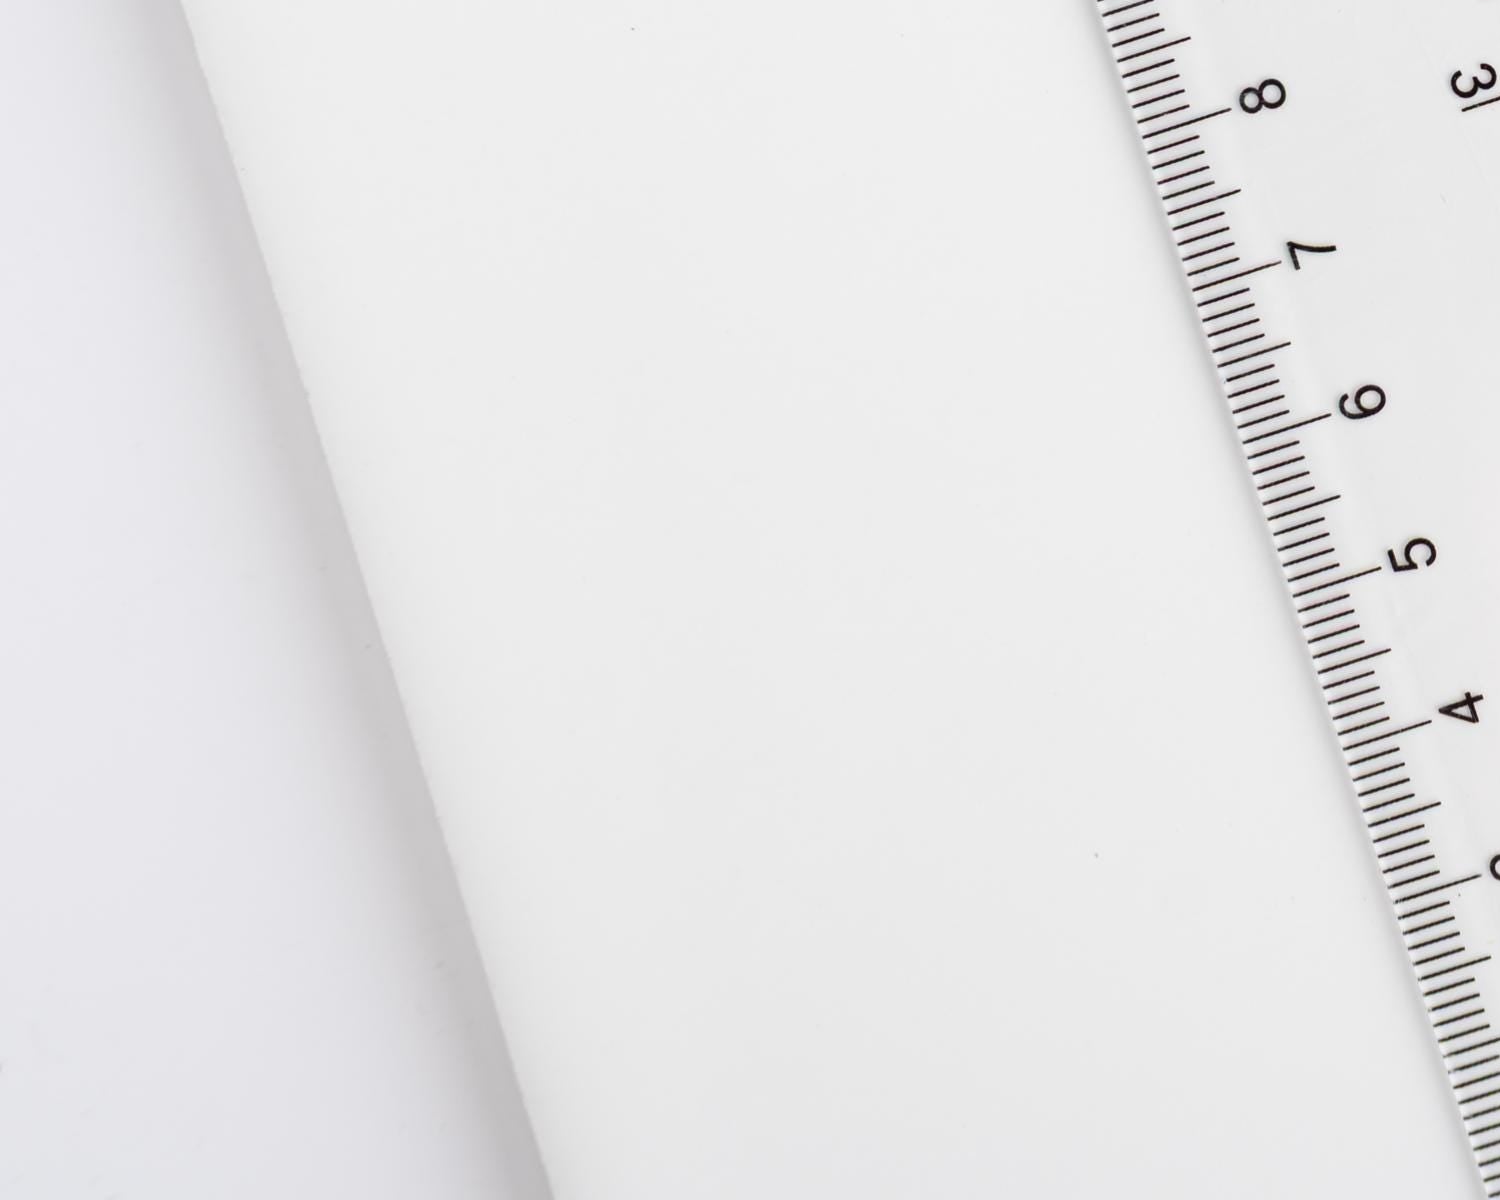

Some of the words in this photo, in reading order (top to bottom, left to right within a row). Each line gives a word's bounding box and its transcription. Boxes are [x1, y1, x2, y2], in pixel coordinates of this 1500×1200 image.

[1238, 78, 1287, 114] 8
[1450, 63, 1497, 99] 3
[1286, 241, 1337, 271] 7
[1338, 384, 1387, 420] 6
[1387, 537, 1437, 573] 5
[1438, 691, 1484, 724] 4
